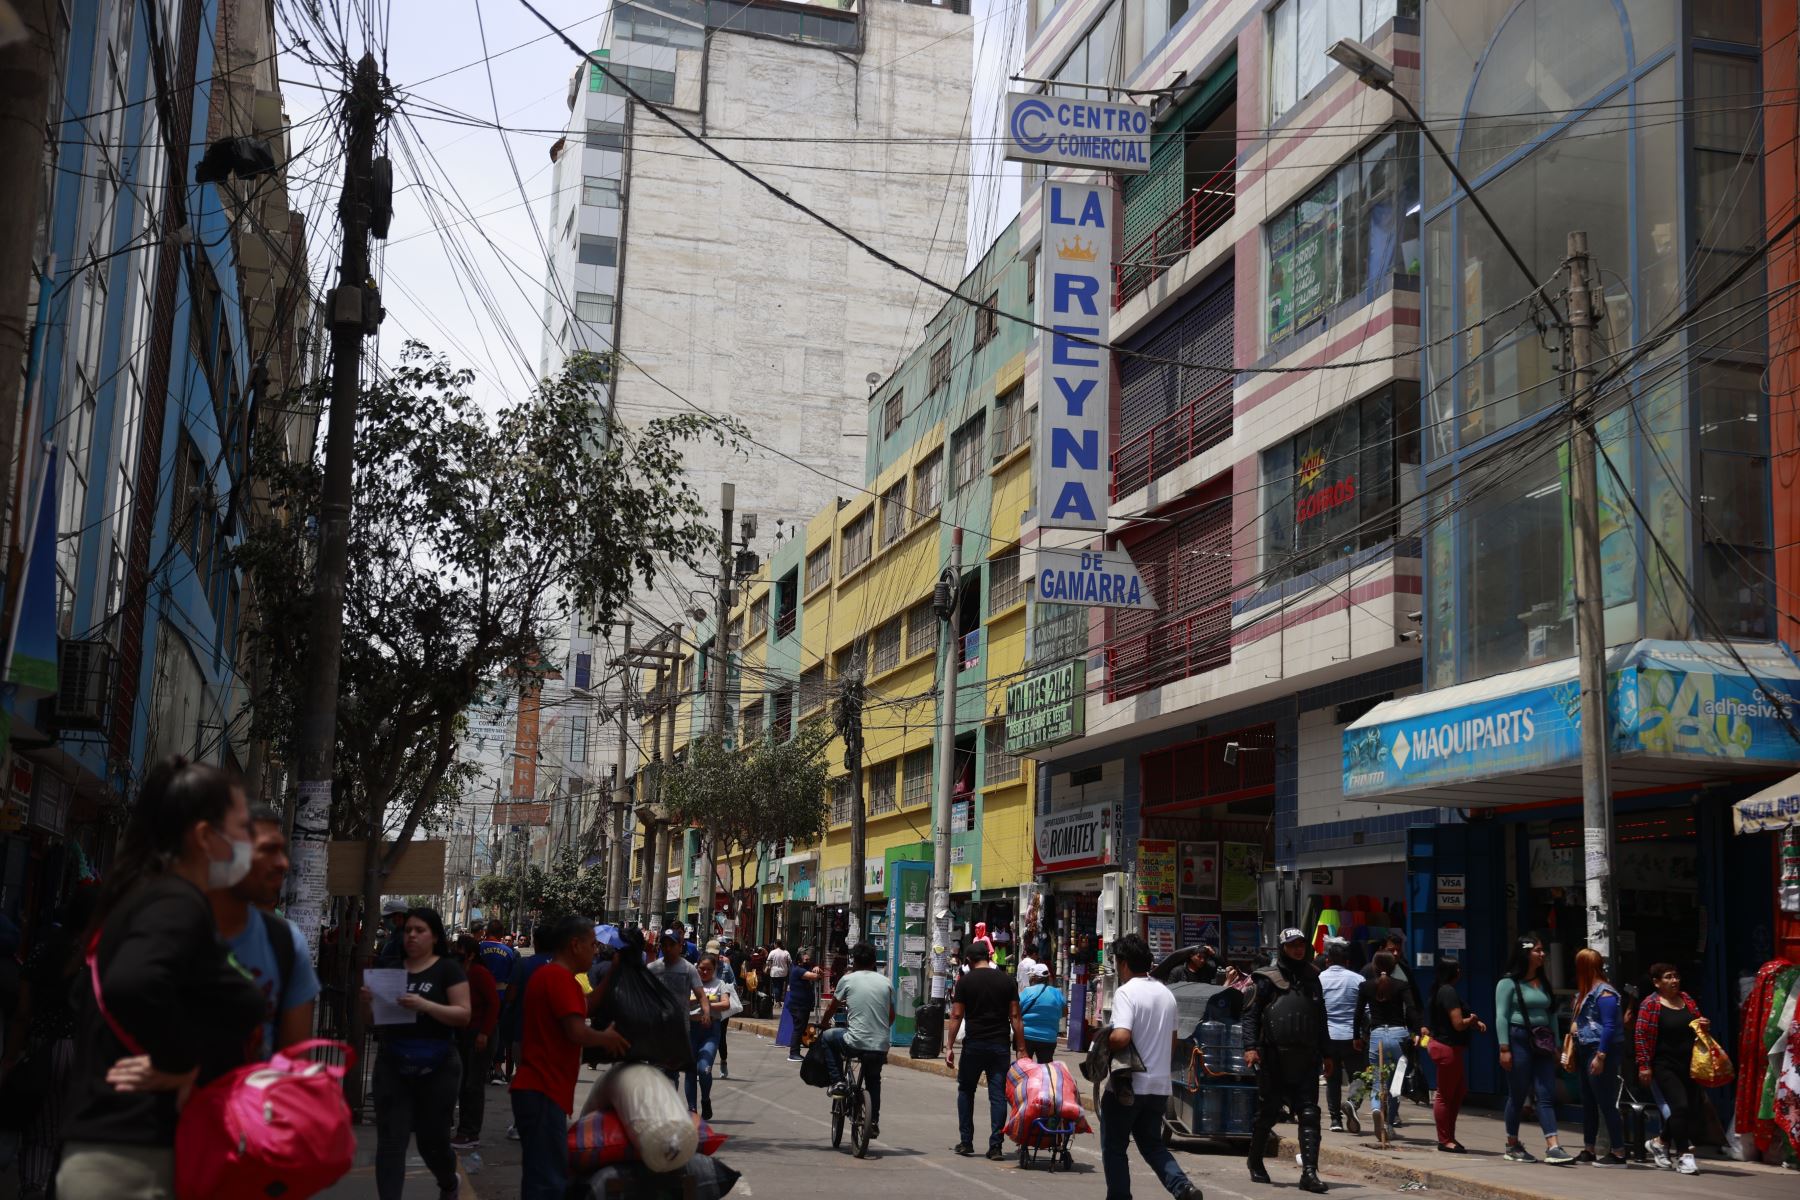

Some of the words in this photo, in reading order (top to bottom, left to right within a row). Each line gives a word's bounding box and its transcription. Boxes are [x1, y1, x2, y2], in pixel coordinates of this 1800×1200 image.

[1057, 103, 1147, 134] CENTRO
[1057, 133, 1147, 163] COMERCIAL
[1050, 187, 1105, 228] LA
[1050, 272, 1101, 521] REYNA
[1080, 552, 1103, 571] DE
[1040, 569, 1141, 605] GAMARRA
[1007, 677, 1046, 724] MOLDES
[1705, 698, 1793, 720] adhesivas
[1412, 707, 1535, 761] MAQUIPARTS
[1050, 822, 1099, 858] ROMATEX
[1114, 804, 1122, 863] ROMATEX
[1441, 879, 1462, 887] VISA
[1441, 895, 1461, 904] VISA
[418, 982, 433, 992] IS
